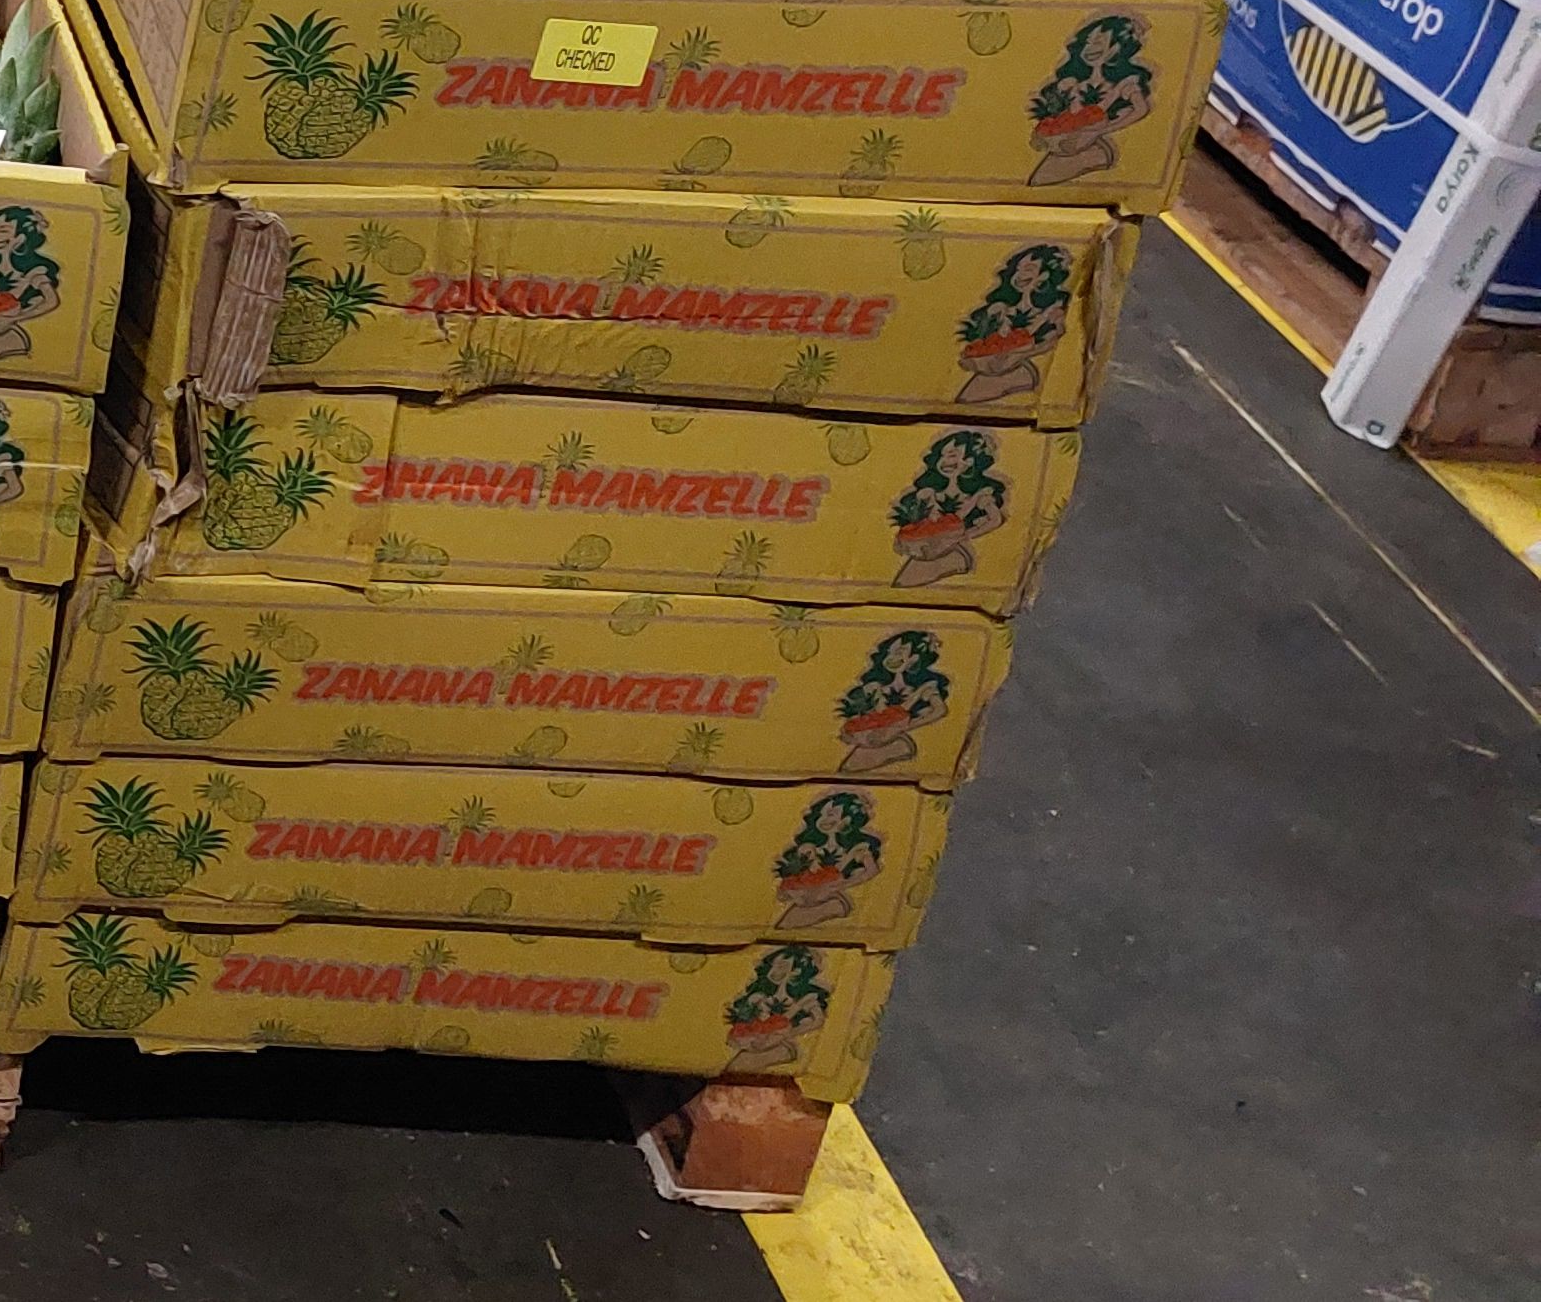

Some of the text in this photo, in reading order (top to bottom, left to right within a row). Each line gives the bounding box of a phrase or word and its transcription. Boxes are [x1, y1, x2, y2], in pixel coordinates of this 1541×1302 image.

[555, 48, 617, 72] CHECKED
[581, 25, 604, 47] QC
[669, 68, 956, 116] MAMZELLE
[611, 286, 888, 337] MAMZELLE
[351, 460, 823, 519] ZNANA MAMZELLE
[295, 665, 767, 716] ZANANA MAMZELLE
[249, 822, 710, 874] ZANANA MAMZELLE
[215, 957, 658, 1020] ZANANA MAMZELLE
